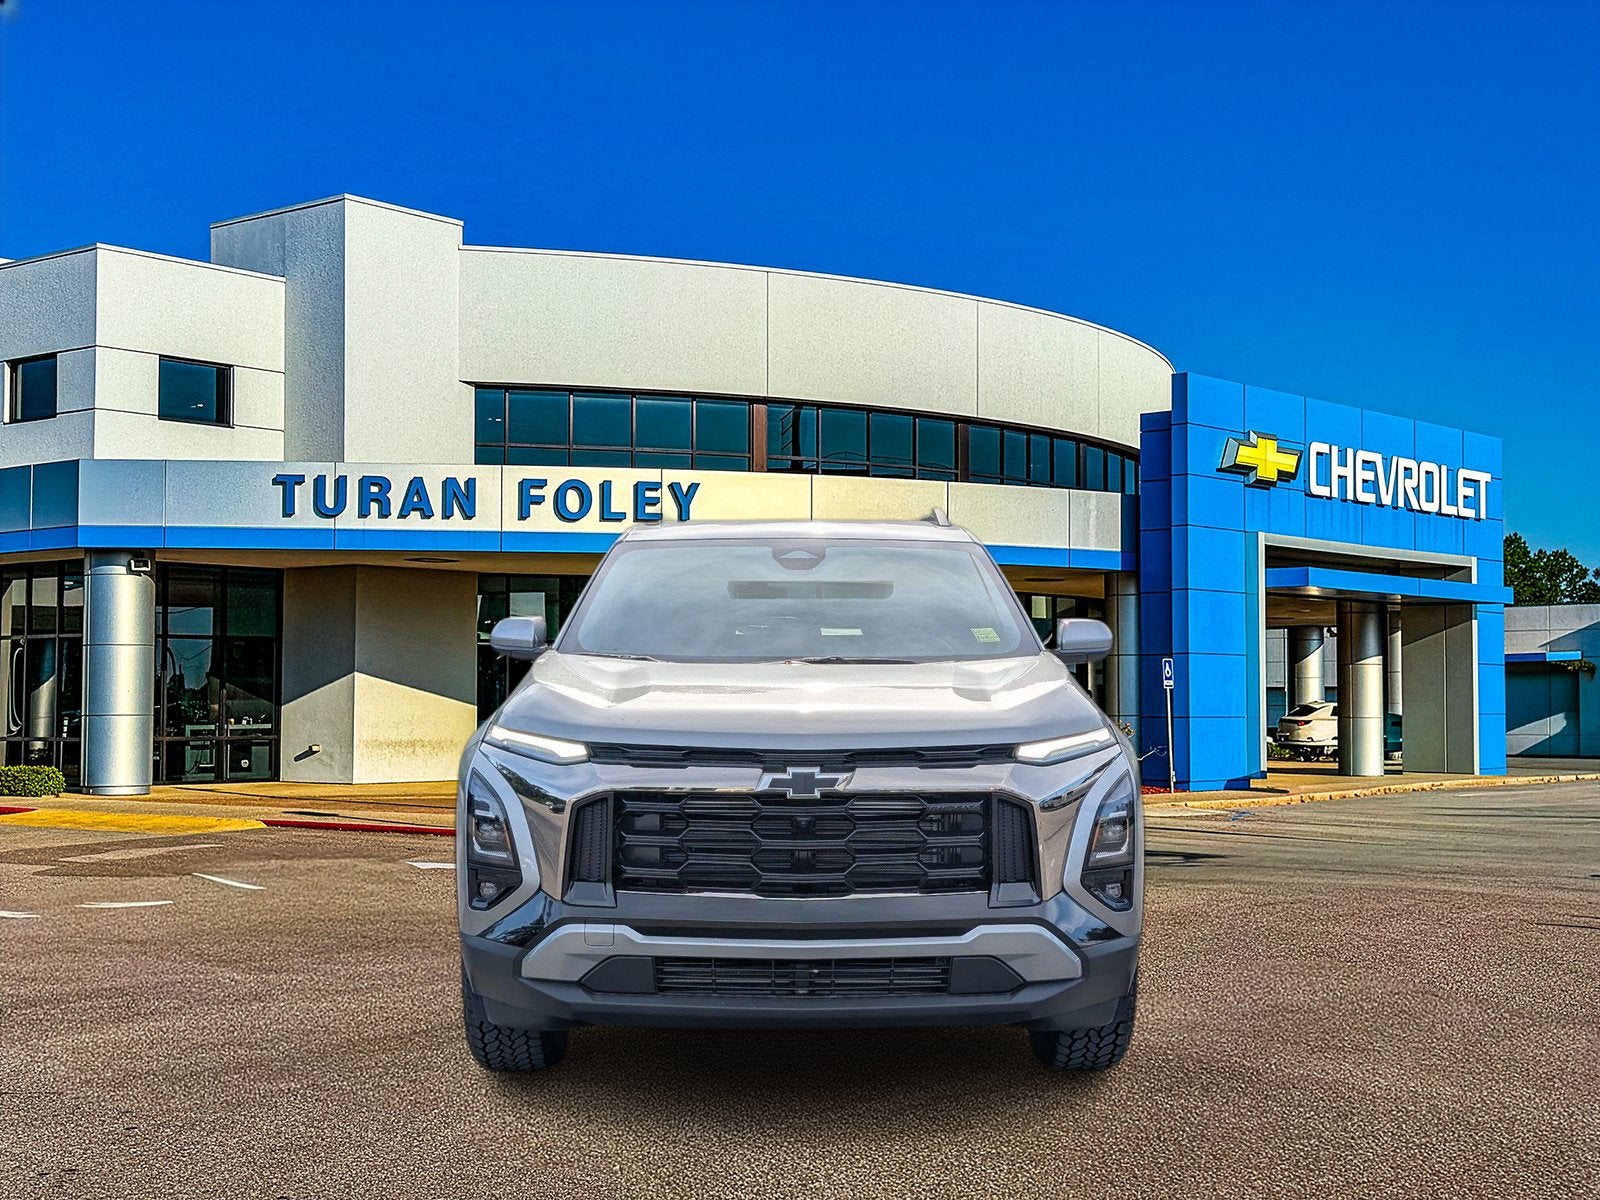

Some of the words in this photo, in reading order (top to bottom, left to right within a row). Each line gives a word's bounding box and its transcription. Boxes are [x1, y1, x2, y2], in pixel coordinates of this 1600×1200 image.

[271, 474, 477, 520] TURAN
[517, 478, 701, 522] FOLEY
[1308, 441, 1492, 520] CHEVROLET
